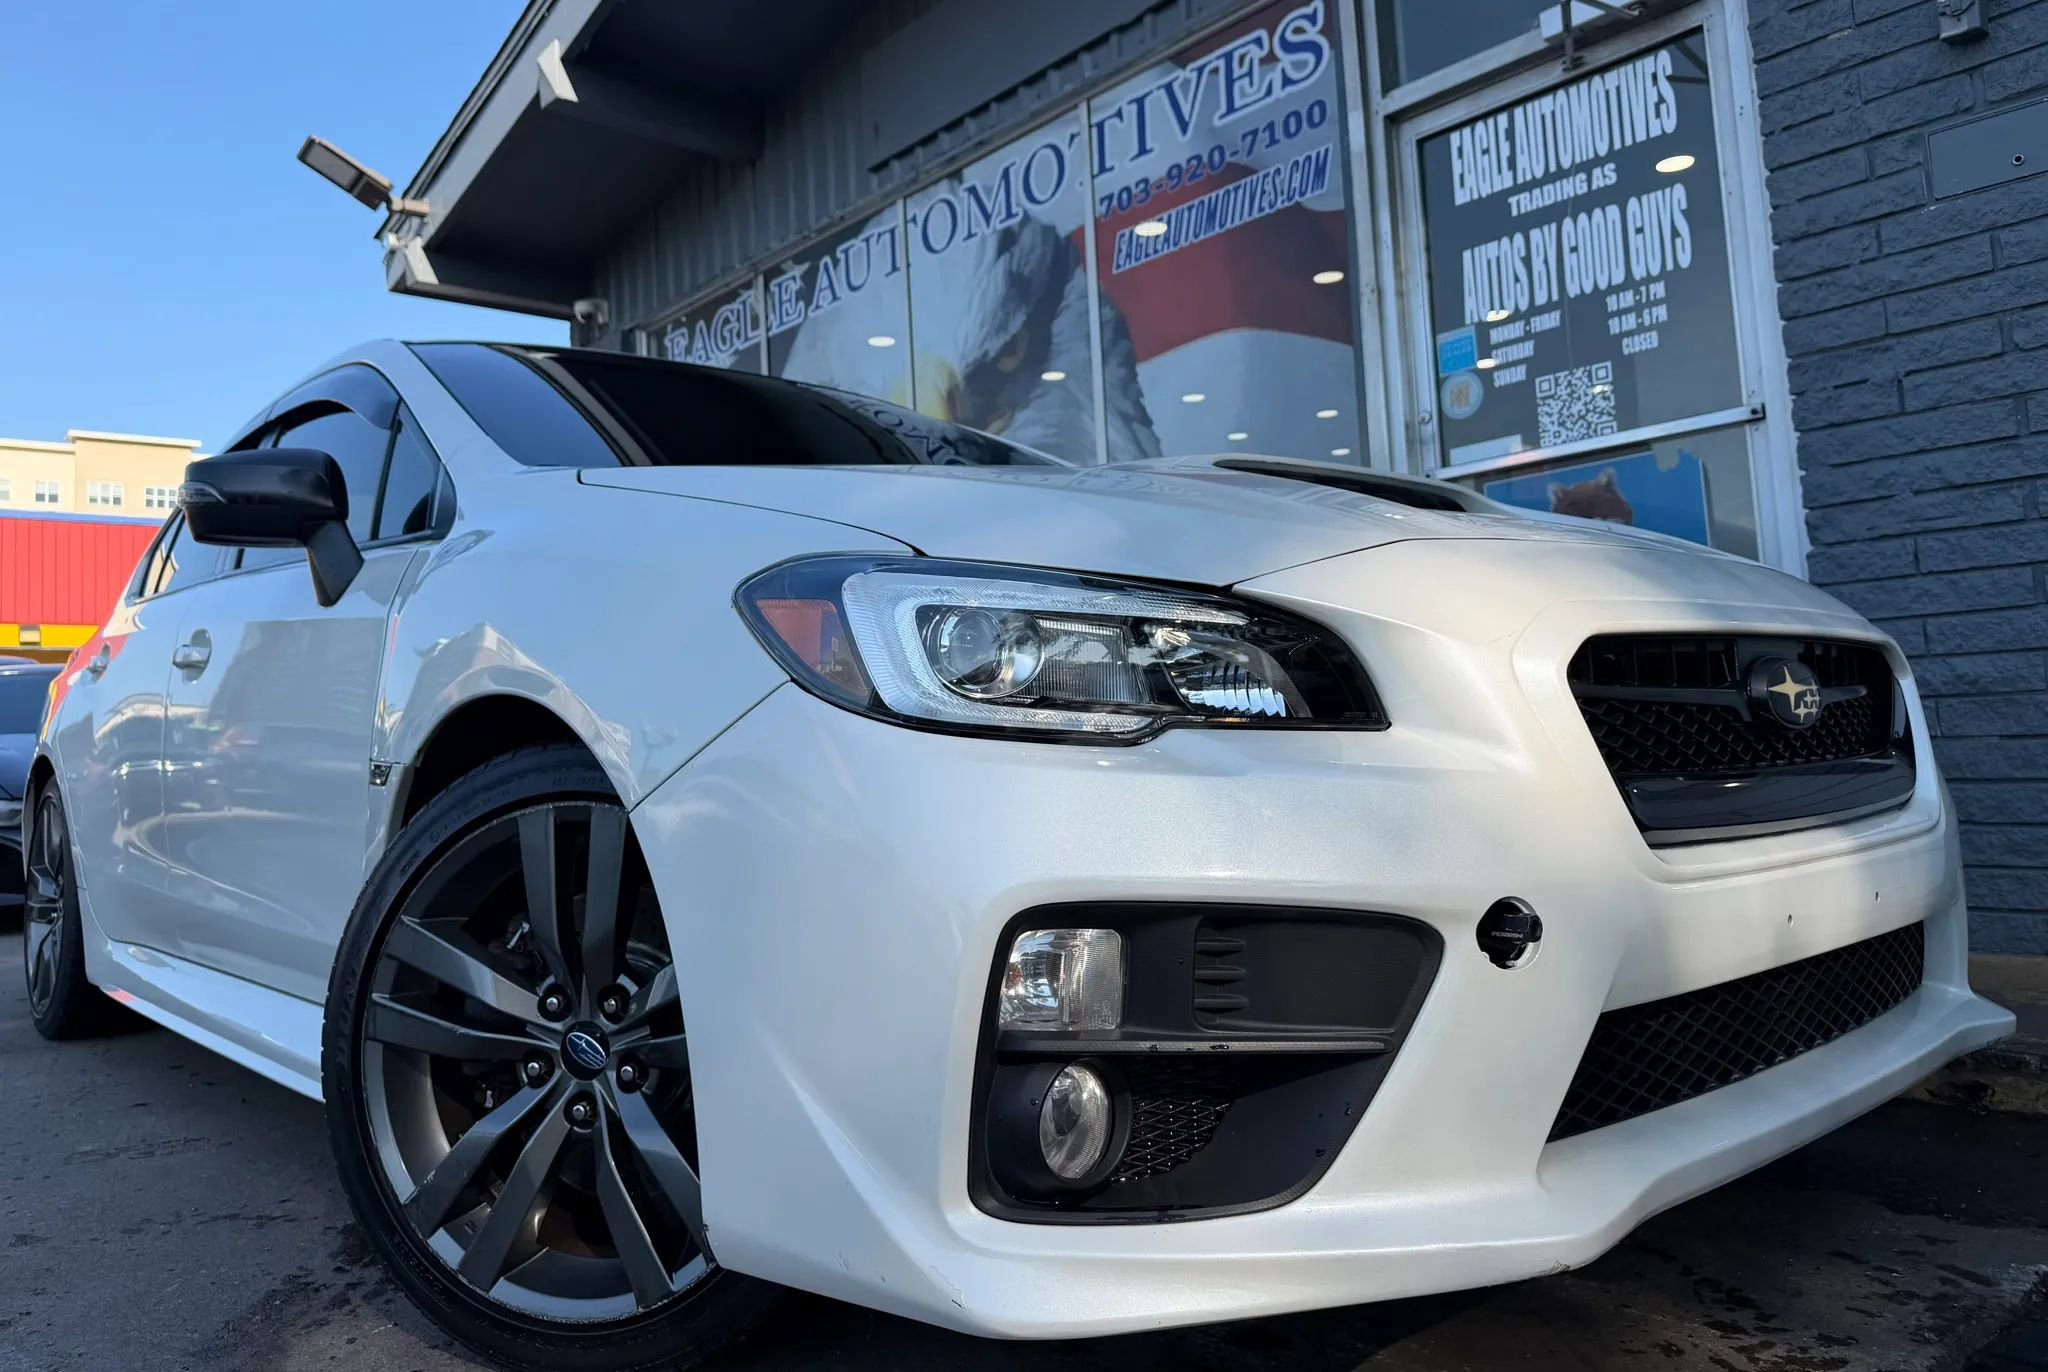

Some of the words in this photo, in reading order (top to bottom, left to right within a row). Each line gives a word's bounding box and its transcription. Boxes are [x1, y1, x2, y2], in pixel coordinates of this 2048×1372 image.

[1450, 111, 1513, 207] EAGLE
[1513, 50, 1677, 185] AUTOMOTIVES
[664, 271, 804, 363] EAGLE
[809, 3, 1330, 318] AUTOMOTIVES
[1099, 98, 1328, 220] 703-920-7100
[1113, 145, 1332, 274] EAGLEAUTOMOTIVES.COM
[1508, 172, 1589, 217] TRADING
[1592, 162, 1618, 191] AS
[1462, 231, 1530, 325] AUTOS
[1529, 222, 1559, 307] BY
[1561, 204, 1626, 299] GOOD
[1626, 182, 1692, 281] GUYS
[1639, 284, 1647, 304] 7
[1649, 280, 1665, 301] PM
[1642, 307, 1652, 327] 6
[1652, 304, 1668, 324] PM
[1492, 340, 1534, 366] SATURDAY
[1622, 331, 1659, 355] CLOSED
[1493, 363, 1527, 387] SUNDAY
